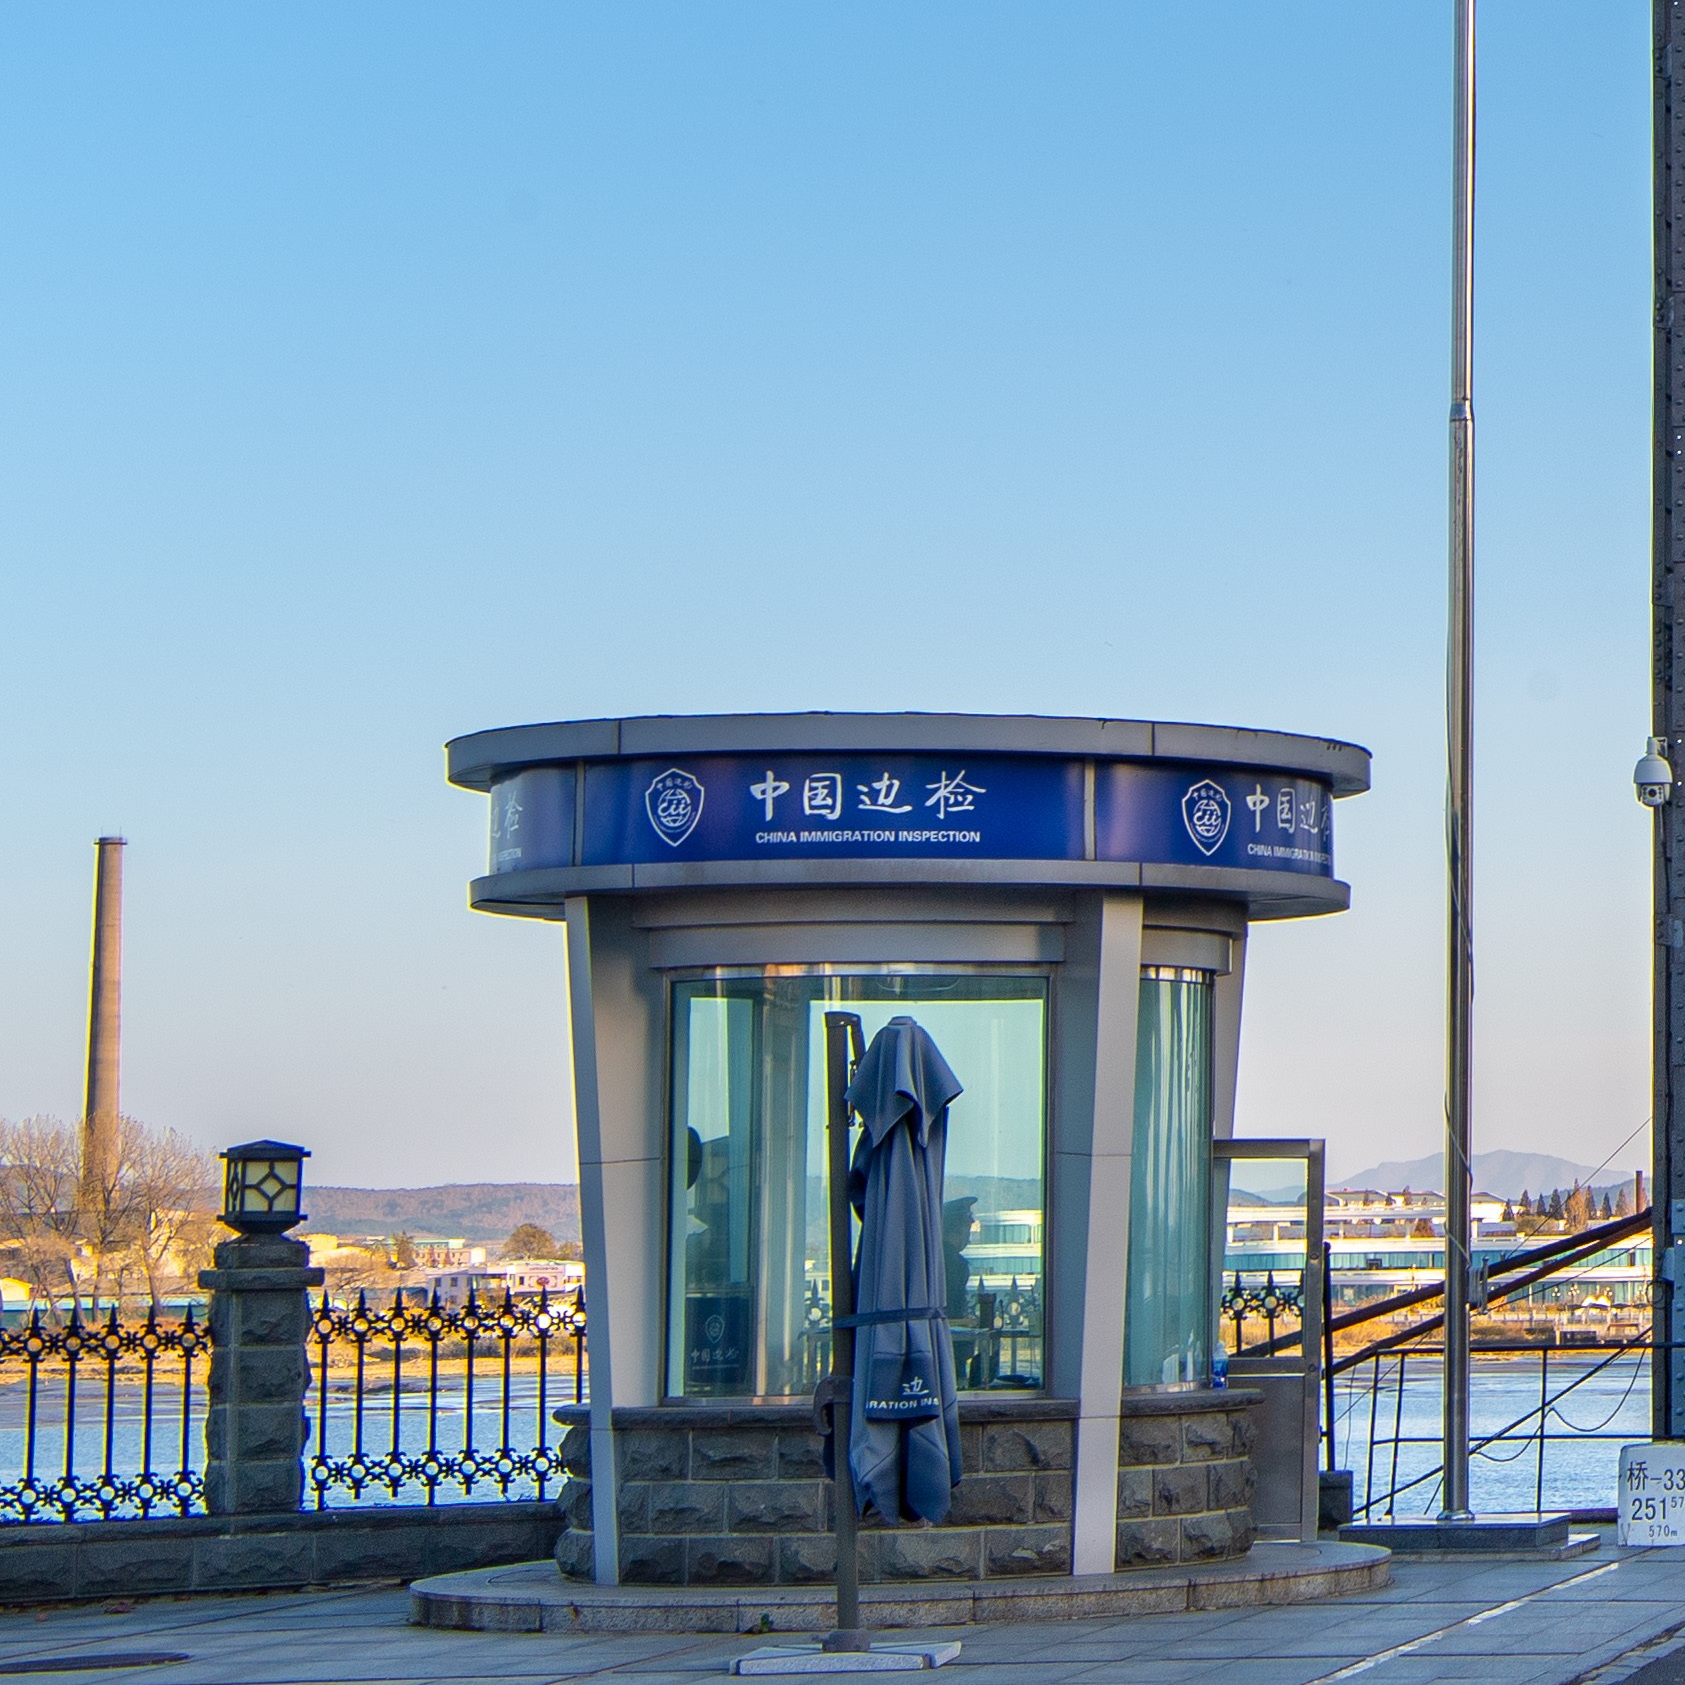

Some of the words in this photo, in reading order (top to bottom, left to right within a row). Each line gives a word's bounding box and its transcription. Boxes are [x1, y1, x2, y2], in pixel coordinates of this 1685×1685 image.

[750, 770, 987, 822] 中国边检
[756, 832, 797, 843] CHINA
[800, 831, 895, 843] IMMIGRATION
[898, 831, 981, 843] INSPECTION
[1648, 1524, 1678, 1538] 570m
